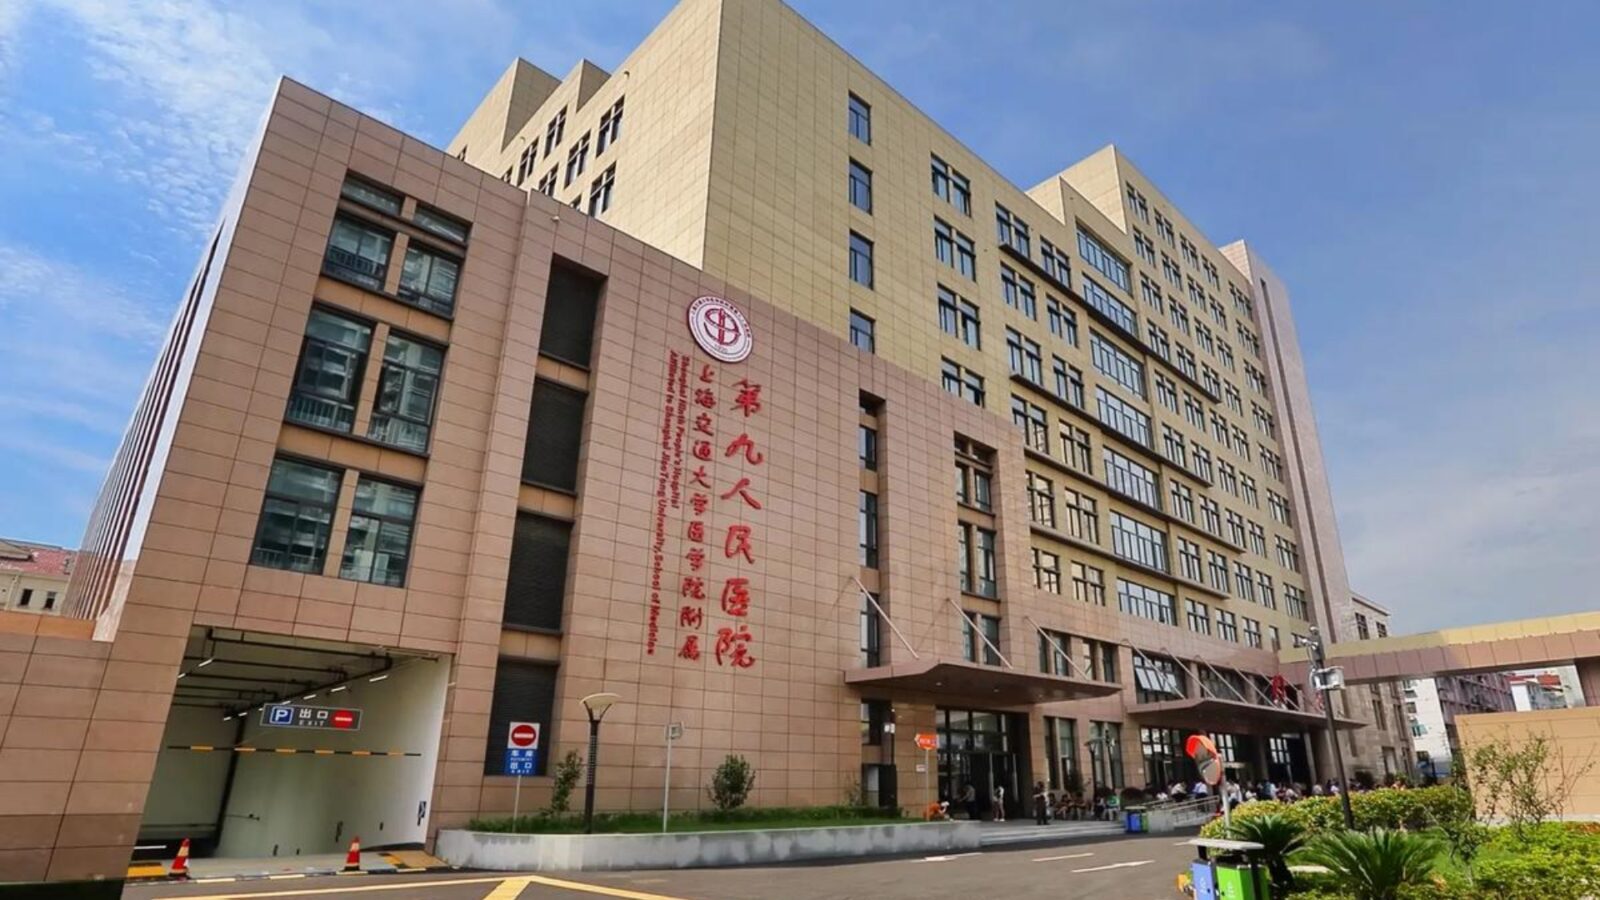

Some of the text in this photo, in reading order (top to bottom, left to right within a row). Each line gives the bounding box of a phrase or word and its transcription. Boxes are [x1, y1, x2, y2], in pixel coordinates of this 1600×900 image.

[678, 355, 690, 398] Shanghai
[662, 405, 674, 450] Shanghai
[678, 399, 687, 425] Ninth
[671, 467, 682, 509] Hospital
[716, 378, 764, 669] 第九人民医院
[275, 709, 289, 722] P
[298, 708, 329, 719] 出口
